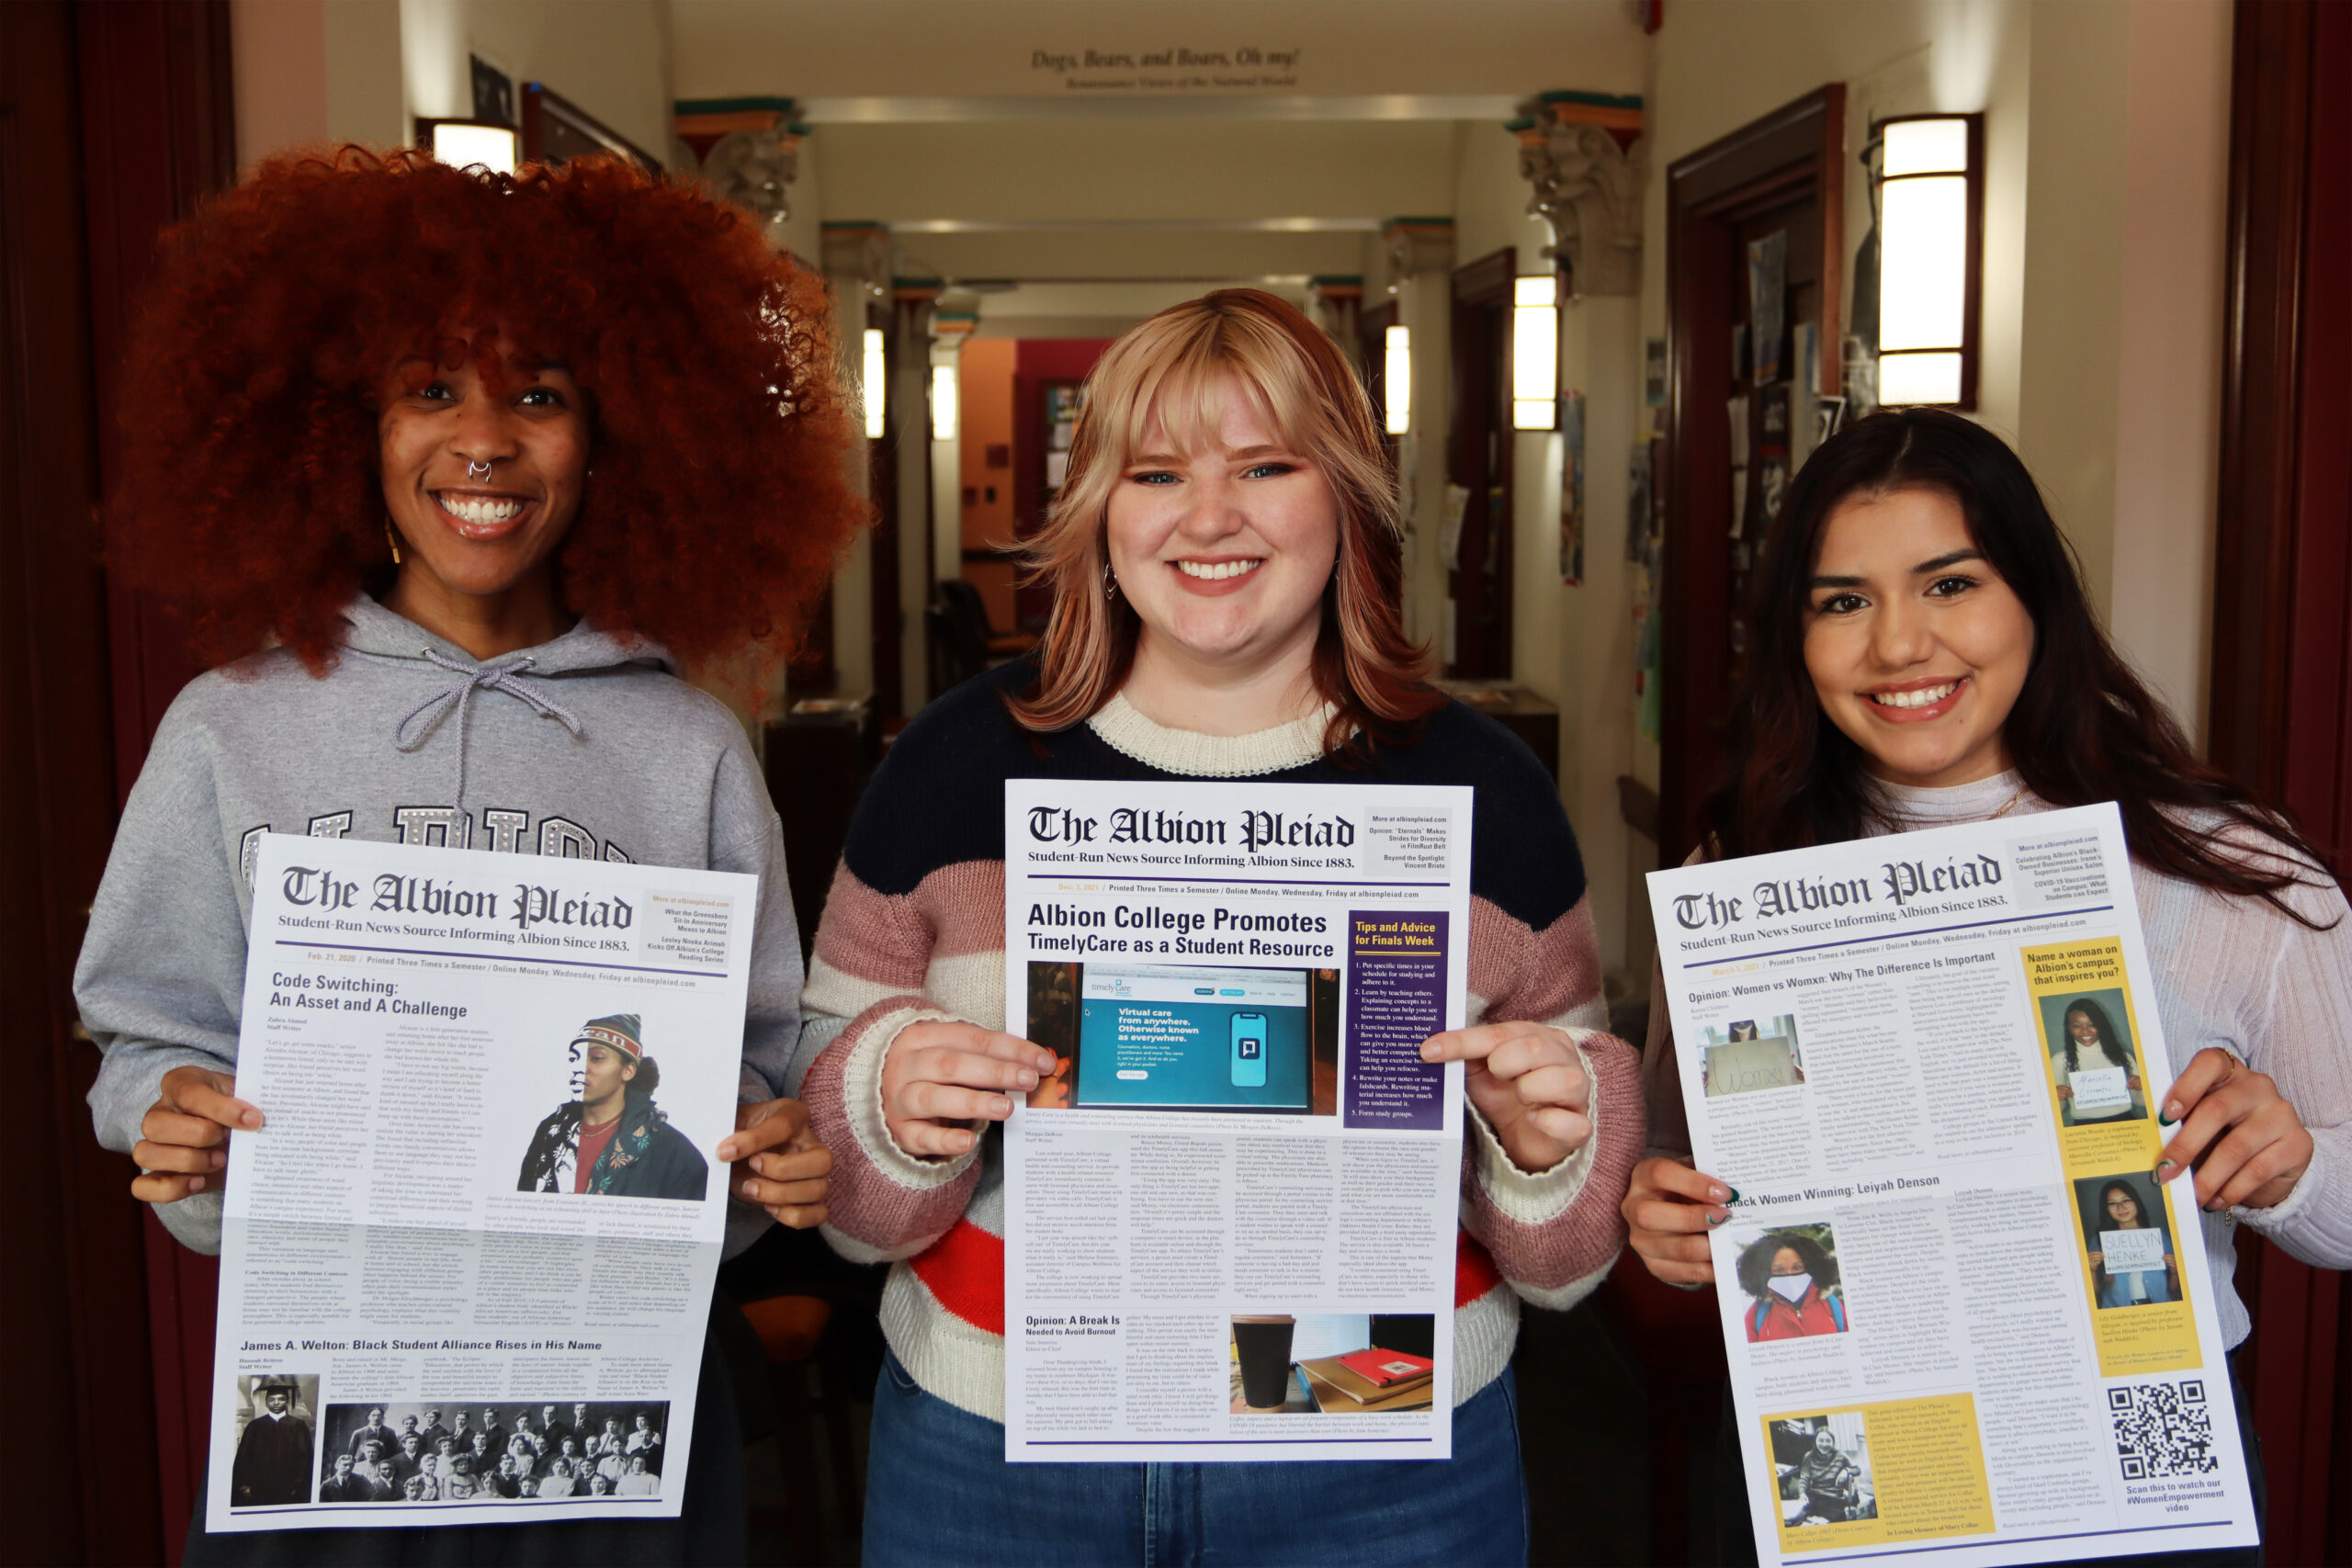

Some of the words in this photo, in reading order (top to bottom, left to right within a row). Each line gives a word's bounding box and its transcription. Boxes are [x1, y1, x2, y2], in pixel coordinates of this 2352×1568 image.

[1028, 807, 1097, 846] The
[1109, 808, 1227, 845] Albion
[1239, 810, 1354, 852] Pleiad
[1028, 852, 1103, 862] Student-Run
[1107, 853, 1138, 863] News
[1141, 854, 1181, 863] Source
[1184, 854, 1245, 868] Informing
[1248, 856, 1287, 866] Albion
[1291, 857, 1322, 867] Since
[1326, 858, 1354, 868] 1883.
[282, 866, 358, 912] The
[370, 874, 498, 919] Albion
[510, 884, 632, 930] Pleiad
[1250, 888, 1279, 897] Monday,
[1282, 889, 1323, 897] Wednesday,
[1326, 889, 1347, 897] Friday
[1358, 890, 1419, 898] albionpleiad.com
[1672, 892, 1743, 930] The
[1753, 875, 1872, 919] Albion
[1882, 854, 2002, 906] Pleiad
[1028, 904, 1104, 927] Albion
[1114, 905, 1204, 934] College
[1214, 908, 1326, 932] Promotes
[1355, 921, 1376, 933] Tips
[1379, 922, 1397, 931] and
[1400, 922, 1435, 932] Advice
[1680, 933, 1755, 951] Student-Run
[1757, 928, 1789, 939] News
[1791, 921, 1831, 934] Source
[1834, 911, 1896, 928] Informing
[1899, 906, 1939, 919] Albion
[1941, 901, 1974, 912] Since
[1977, 896, 2007, 908] 1883.
[278, 915, 362, 931] Student-Run
[366, 921, 400, 933] News
[403, 925, 447, 937] Source
[449, 928, 514, 944] Informing
[517, 932, 560, 945] Albion
[563, 936, 596, 948] Since
[599, 940, 629, 951] 1883.
[1355, 934, 1369, 944] for
[1372, 935, 1402, 945] Finals
[1405, 935, 1434, 945] Week
[1027, 932, 1127, 954] TimelyCare
[1134, 941, 1153, 953] as
[1175, 936, 1243, 954] Student
[1250, 939, 1333, 957] Resource
[2027, 953, 2055, 964] Name
[2065, 948, 2103, 959] woman
[2105, 944, 2117, 953] on
[2033, 976, 2054, 985] that
[2054, 971, 2094, 983] inspires
[2097, 966, 2120, 979] you?
[2035, 961, 2074, 976] Albion's
[2075, 958, 2116, 970] campus
[273, 972, 311, 988] Code
[316, 975, 398, 997] Switching:
[1689, 990, 1730, 1004] Opinion:
[1732, 984, 1770, 996] Women
[1786, 976, 1826, 987] Womxn:
[1829, 971, 1852, 981] Why
[1854, 968, 1873, 977] The
[1876, 962, 1930, 975] Difference
[1933, 958, 1942, 967] Is
[1945, 952, 1996, 966] Important
[269, 991, 290, 1006] An
[296, 993, 339, 1010] Asset
[344, 998, 371, 1011] and
[376, 998, 386, 1012] A
[392, 999, 467, 1020] Challenge
[1119, 1009, 1150, 1017] Virtual
[1118, 1016, 1142, 1024] from
[1144, 1017, 1191, 1027] anywhere.
[1118, 1025, 1166, 1033] Otherwise
[1168, 1026, 1199, 1034] known
[1130, 1034, 1187, 1043] everywhere.
[1758, 1193, 1801, 1205] Women
[1804, 1186, 1854, 1200] Winning:
[1857, 1179, 1894, 1194] Leiyah
[1896, 1177, 1939, 1189] Denson
[2105, 1232, 2162, 1249] SUELLYN
[2108, 1251, 2147, 1263] HENKE
[1026, 1315, 1066, 1327] Opinion:
[1069, 1315, 1076, 1325] A
[1080, 1315, 1108, 1325] Break
[1112, 1315, 1120, 1325] Is
[240, 1340, 281, 1350] James
[285, 1340, 297, 1349] A.
[301, 1340, 348, 1349] Welton:
[353, 1340, 388, 1349] Black
[391, 1340, 437, 1349] Student
[441, 1340, 492, 1349] Alliance
[495, 1340, 526, 1349] Rises
[531, 1340, 541, 1348] in
[545, 1340, 564, 1349] His
[568, 1340, 602, 1349] Name
[2126, 1485, 2147, 1494] Scan
[2149, 1483, 2165, 1492] this
[2177, 1480, 2204, 1489] watch
[2127, 1490, 2224, 1505] #WomenEmpowerment
[2165, 1504, 2188, 1512] video
